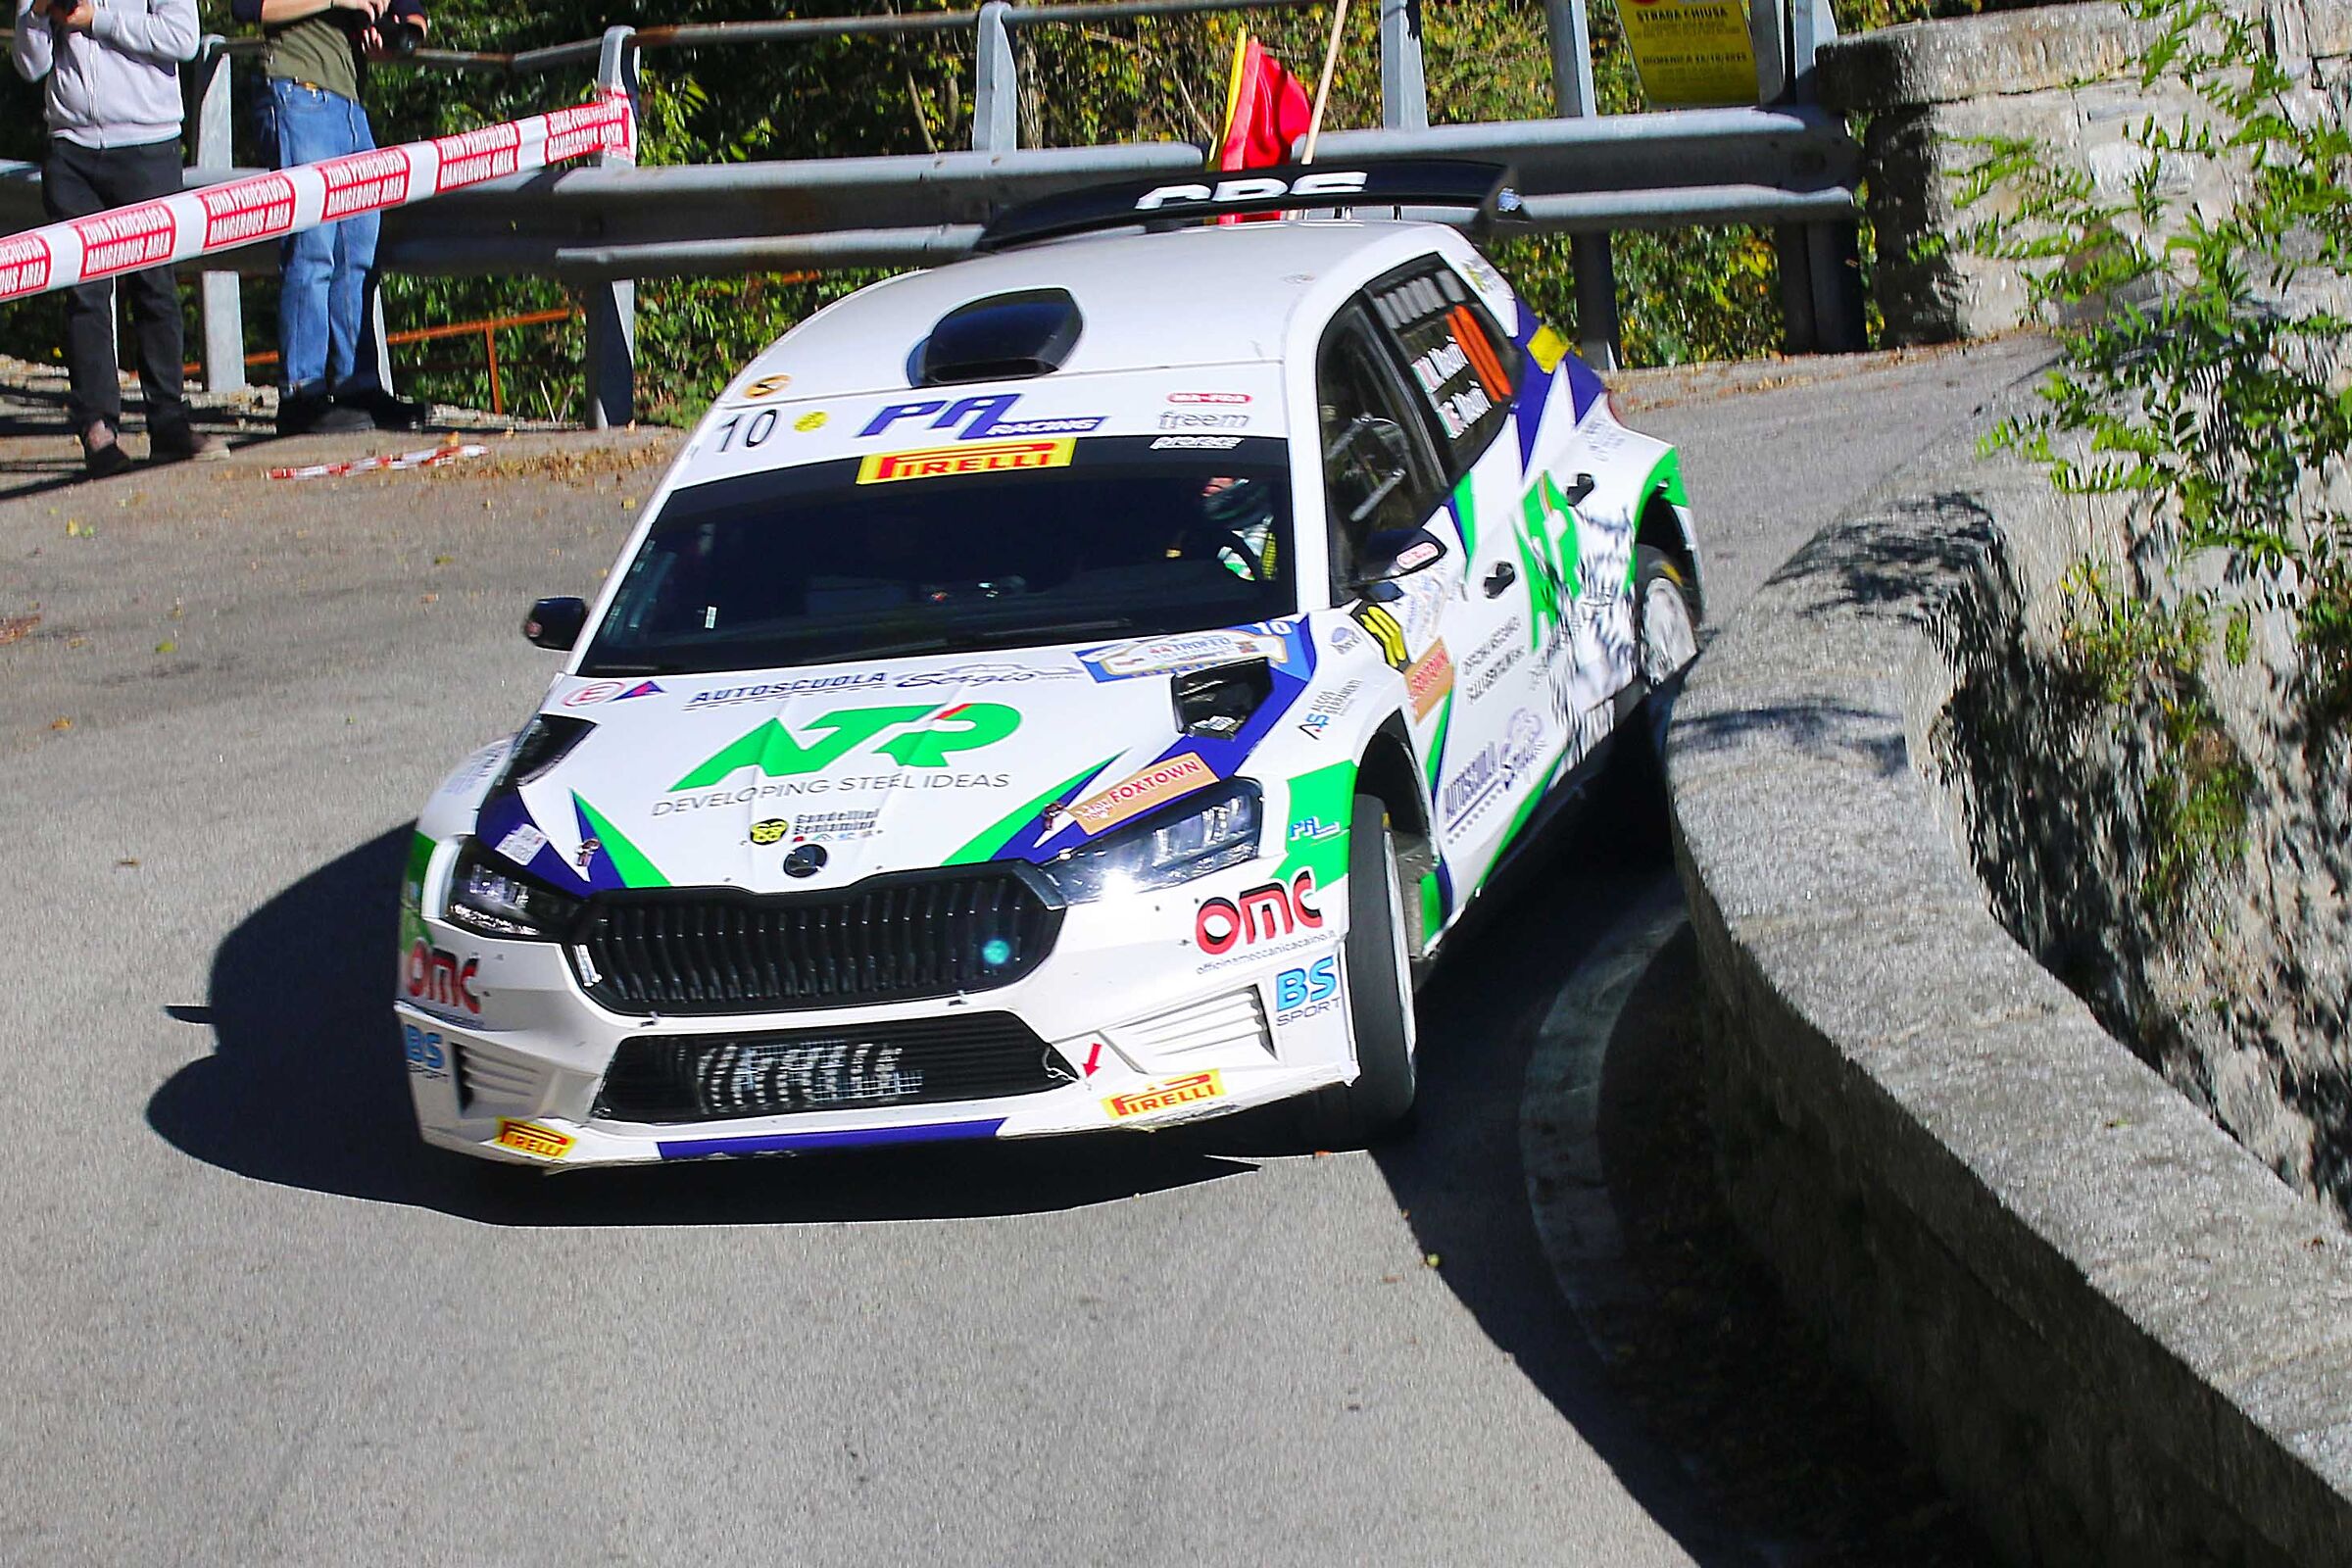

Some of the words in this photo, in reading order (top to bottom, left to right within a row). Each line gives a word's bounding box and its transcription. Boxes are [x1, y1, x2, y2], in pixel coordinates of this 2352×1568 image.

[440, 154, 492, 190] DANGEROUS
[491, 148, 515, 177] AREA
[326, 180, 382, 217] DANGEROUS
[380, 174, 406, 204] AREA
[209, 208, 266, 246] DANGEROUS
[265, 202, 292, 231] AREA
[85, 236, 145, 275] DANGEROUS
[144, 230, 171, 261] AREA
[20, 260, 46, 291] AREA
[717, 409, 778, 454] 10
[985, 418, 1101, 436] RACING
[879, 443, 1056, 480] PIRELLI
[1253, 621, 1293, 636] 10
[689, 672, 886, 704] AUTOSCUOLA
[896, 672, 1037, 688] Sergio
[651, 779, 831, 816] DEVELOPING
[838, 775, 914, 792] STEEL
[923, 773, 1010, 789] IDEAS
[1108, 760, 1201, 804] FOXTOWN
[1276, 955, 1337, 1012] BS
[1276, 996, 1342, 1027] SPORT
[407, 1024, 445, 1069] BS
[1111, 1071, 1216, 1117] PIRELLI
[500, 1120, 567, 1157] PIRELLI
